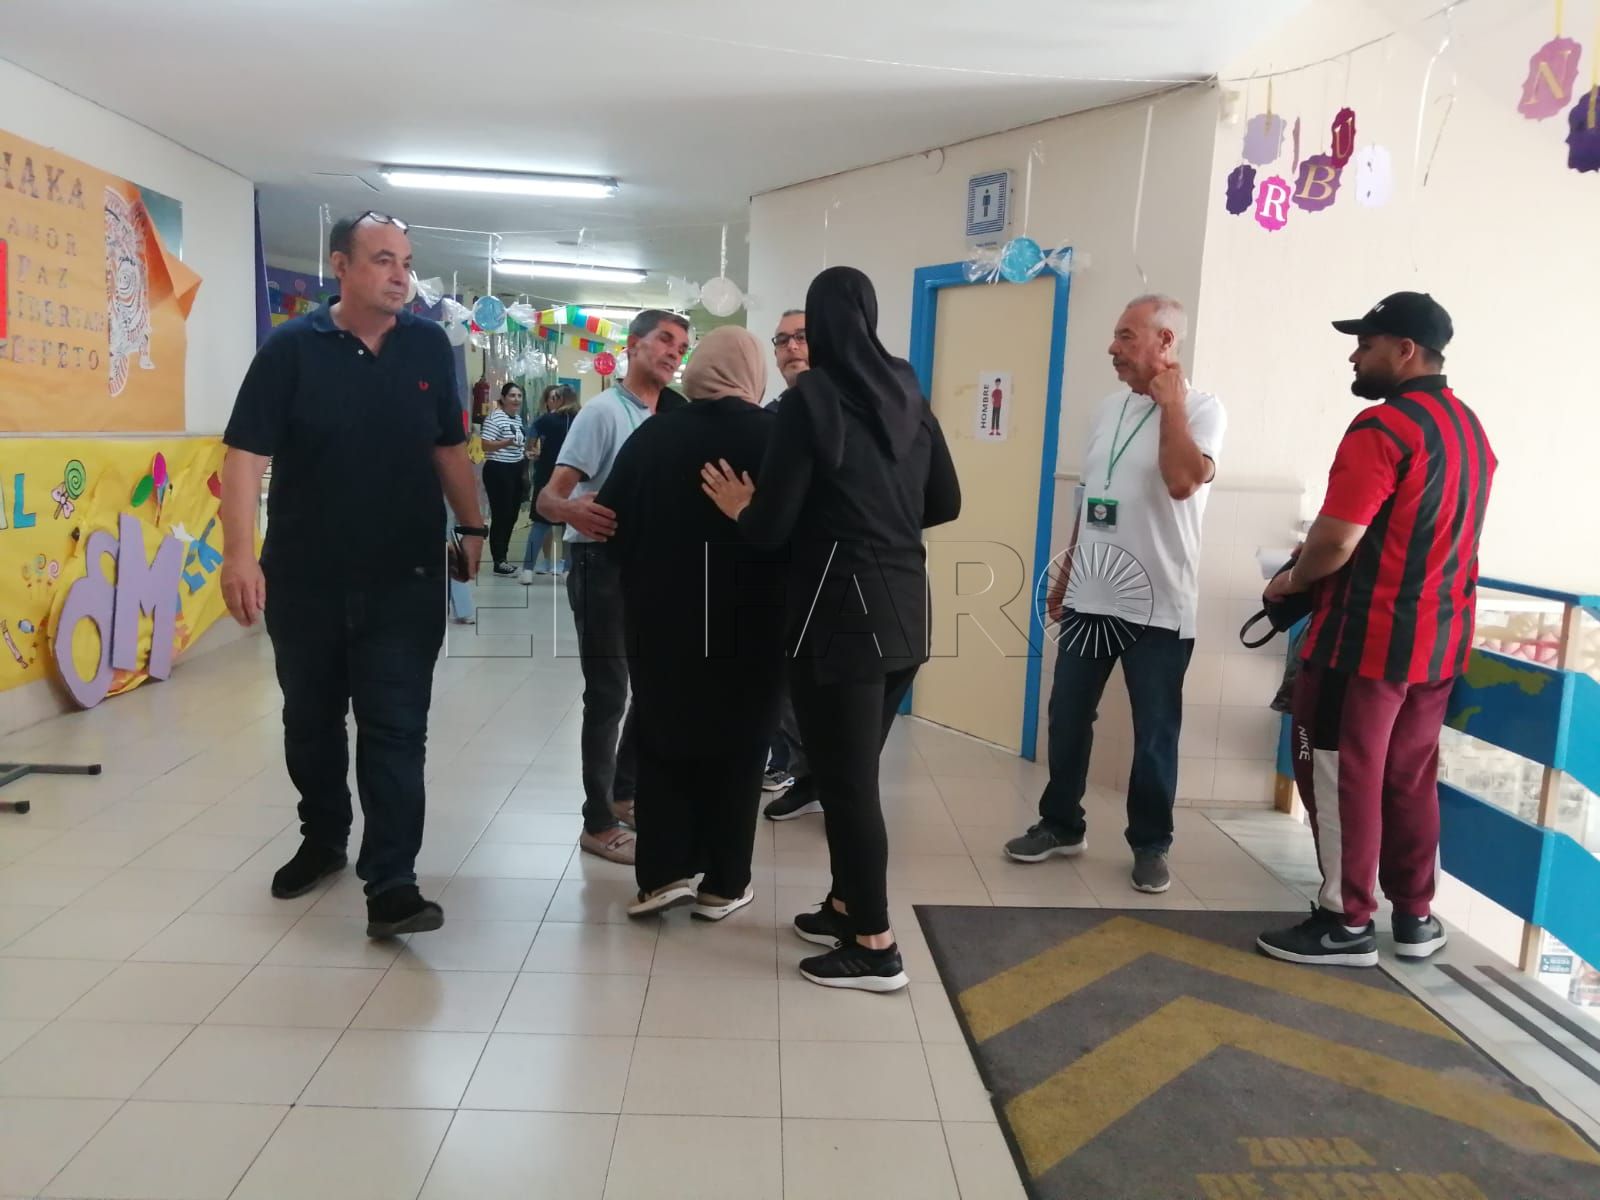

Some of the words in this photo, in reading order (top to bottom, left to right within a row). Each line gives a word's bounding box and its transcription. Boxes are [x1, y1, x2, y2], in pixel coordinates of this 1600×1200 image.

[1295, 164, 1337, 200] B
[1259, 183, 1286, 222] R
[16, 254, 69, 289] PAZ
[7, 290, 105, 332] IBERTAD
[980, 384, 990, 430] HOMBRE
[1297, 725, 1311, 761] NIKE
[1236, 1136, 1377, 1167] ZONA
